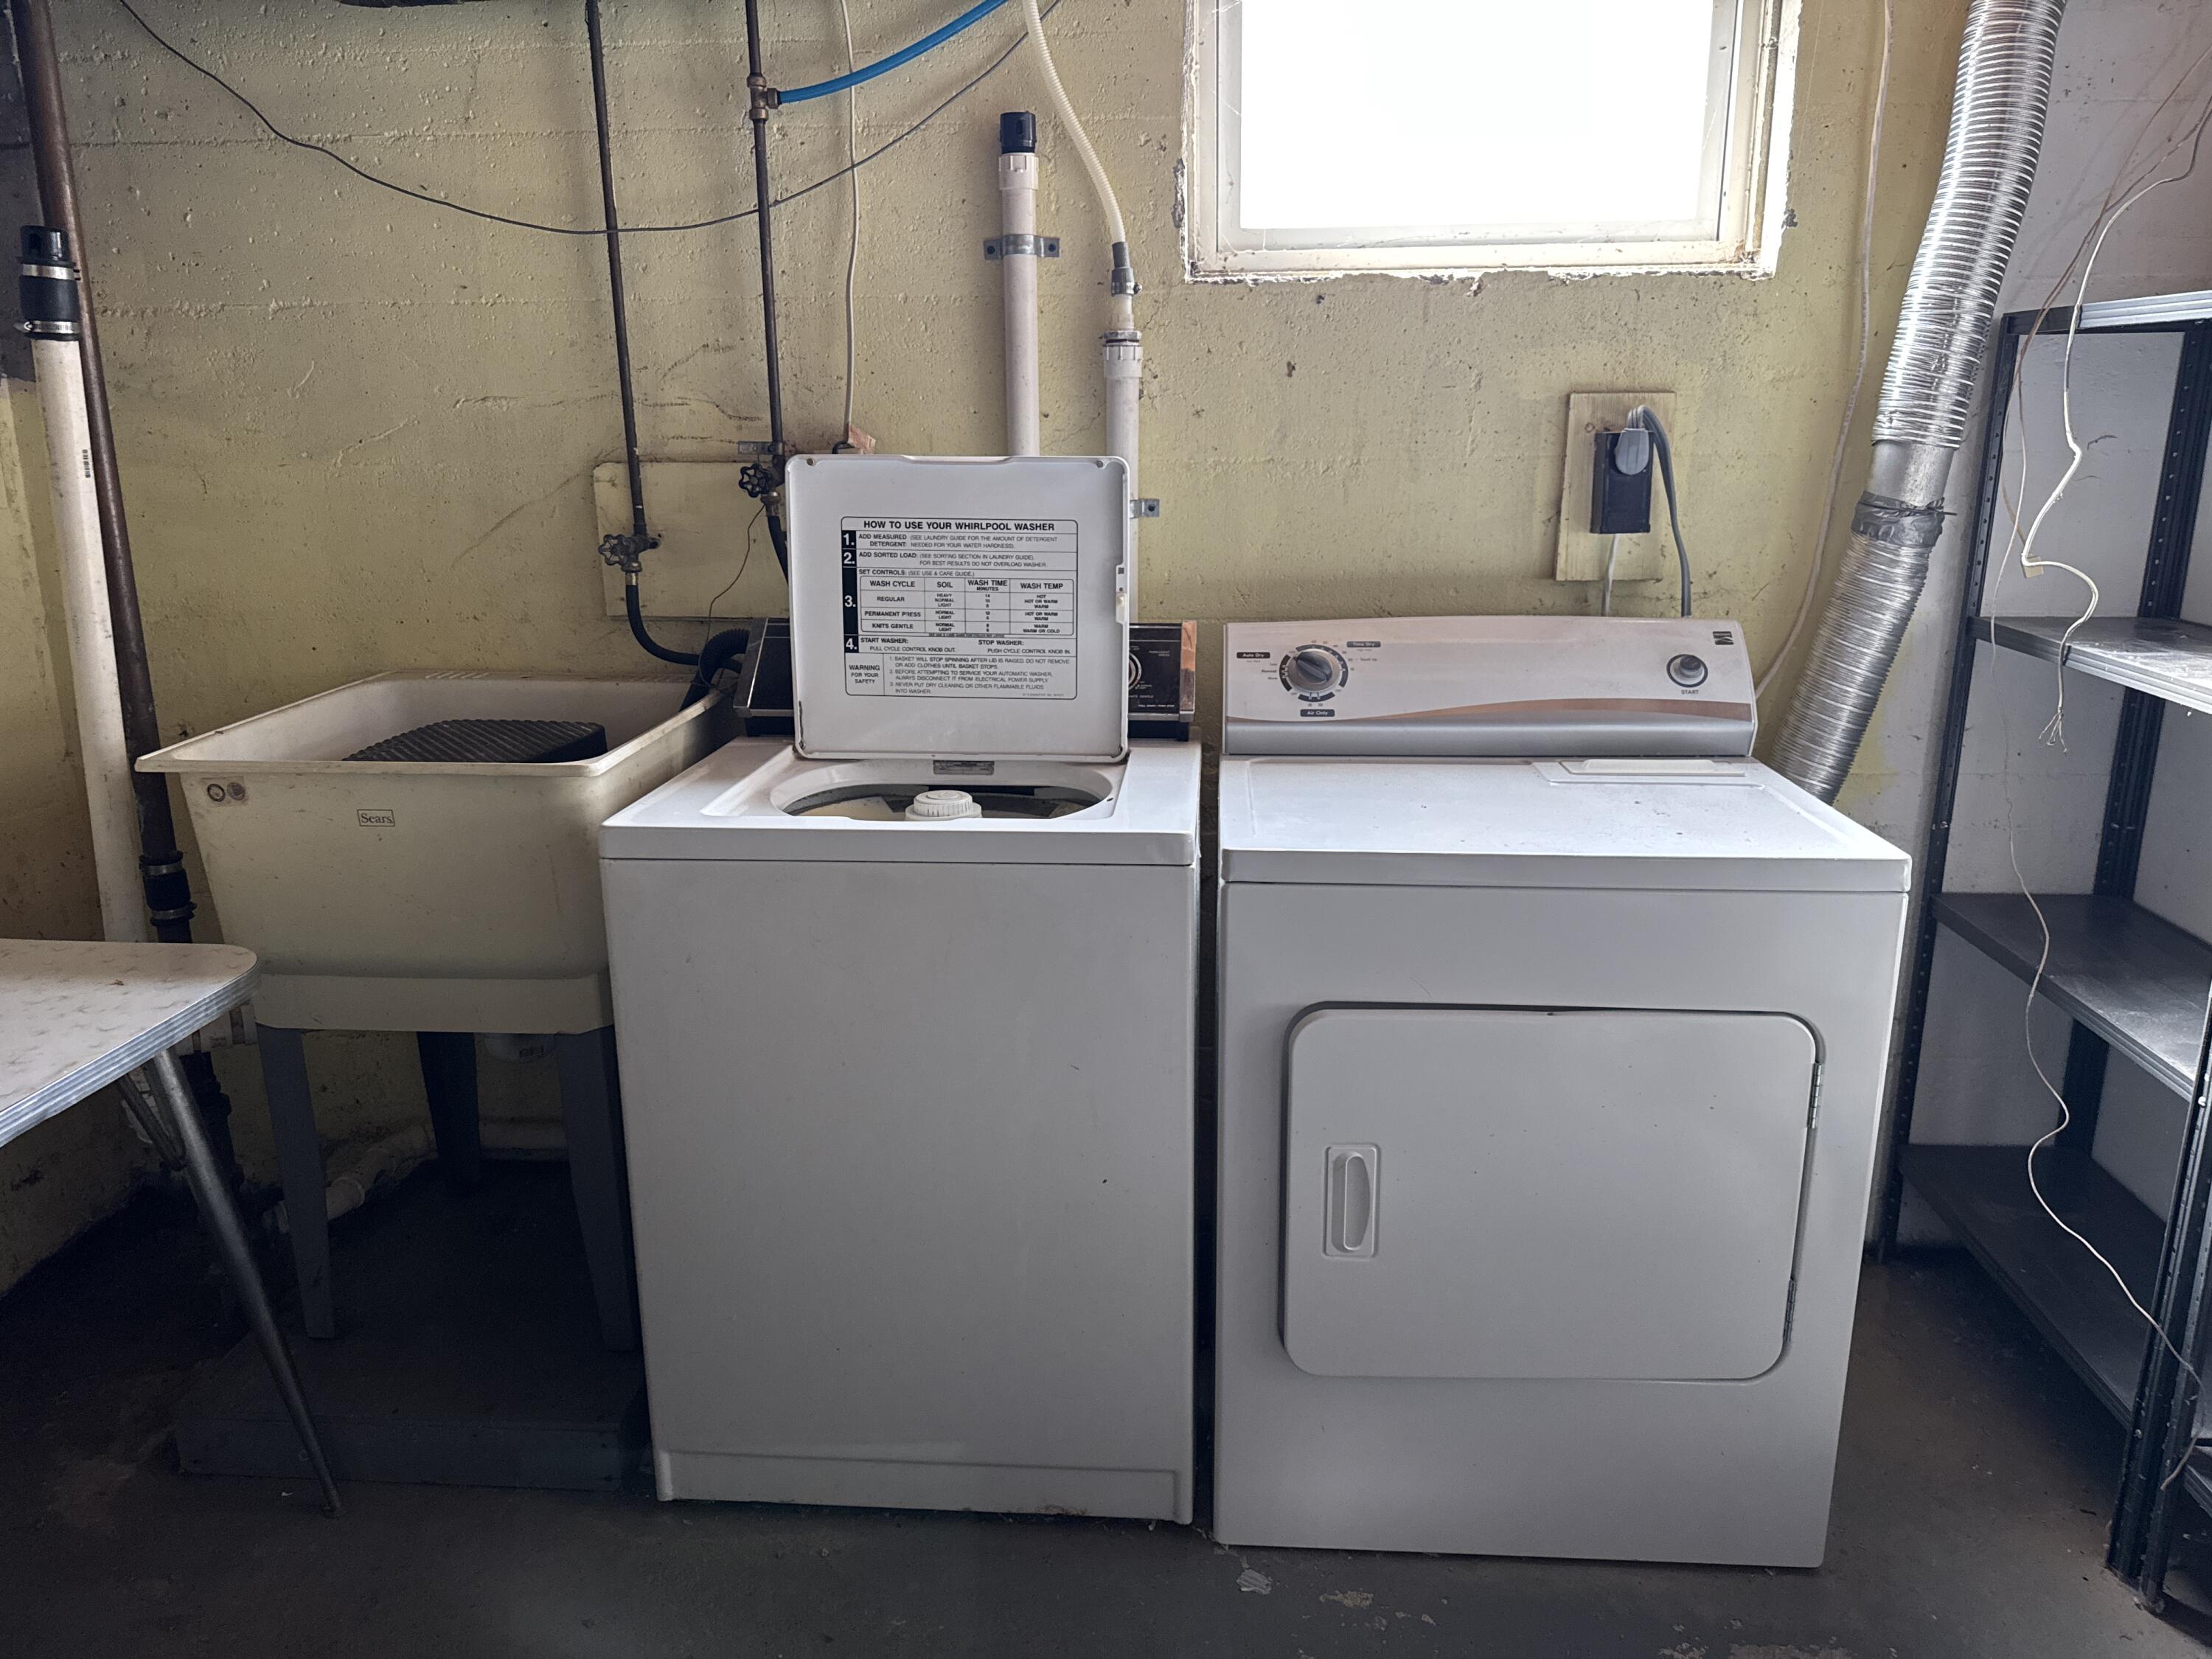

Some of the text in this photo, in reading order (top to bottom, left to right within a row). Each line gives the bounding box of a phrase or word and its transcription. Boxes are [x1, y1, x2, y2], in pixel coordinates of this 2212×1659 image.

[844, 534, 854, 546] 1.
[844, 552, 855, 564] 2.
[845, 595, 856, 607] 3.
[846, 638, 858, 650] 4.
